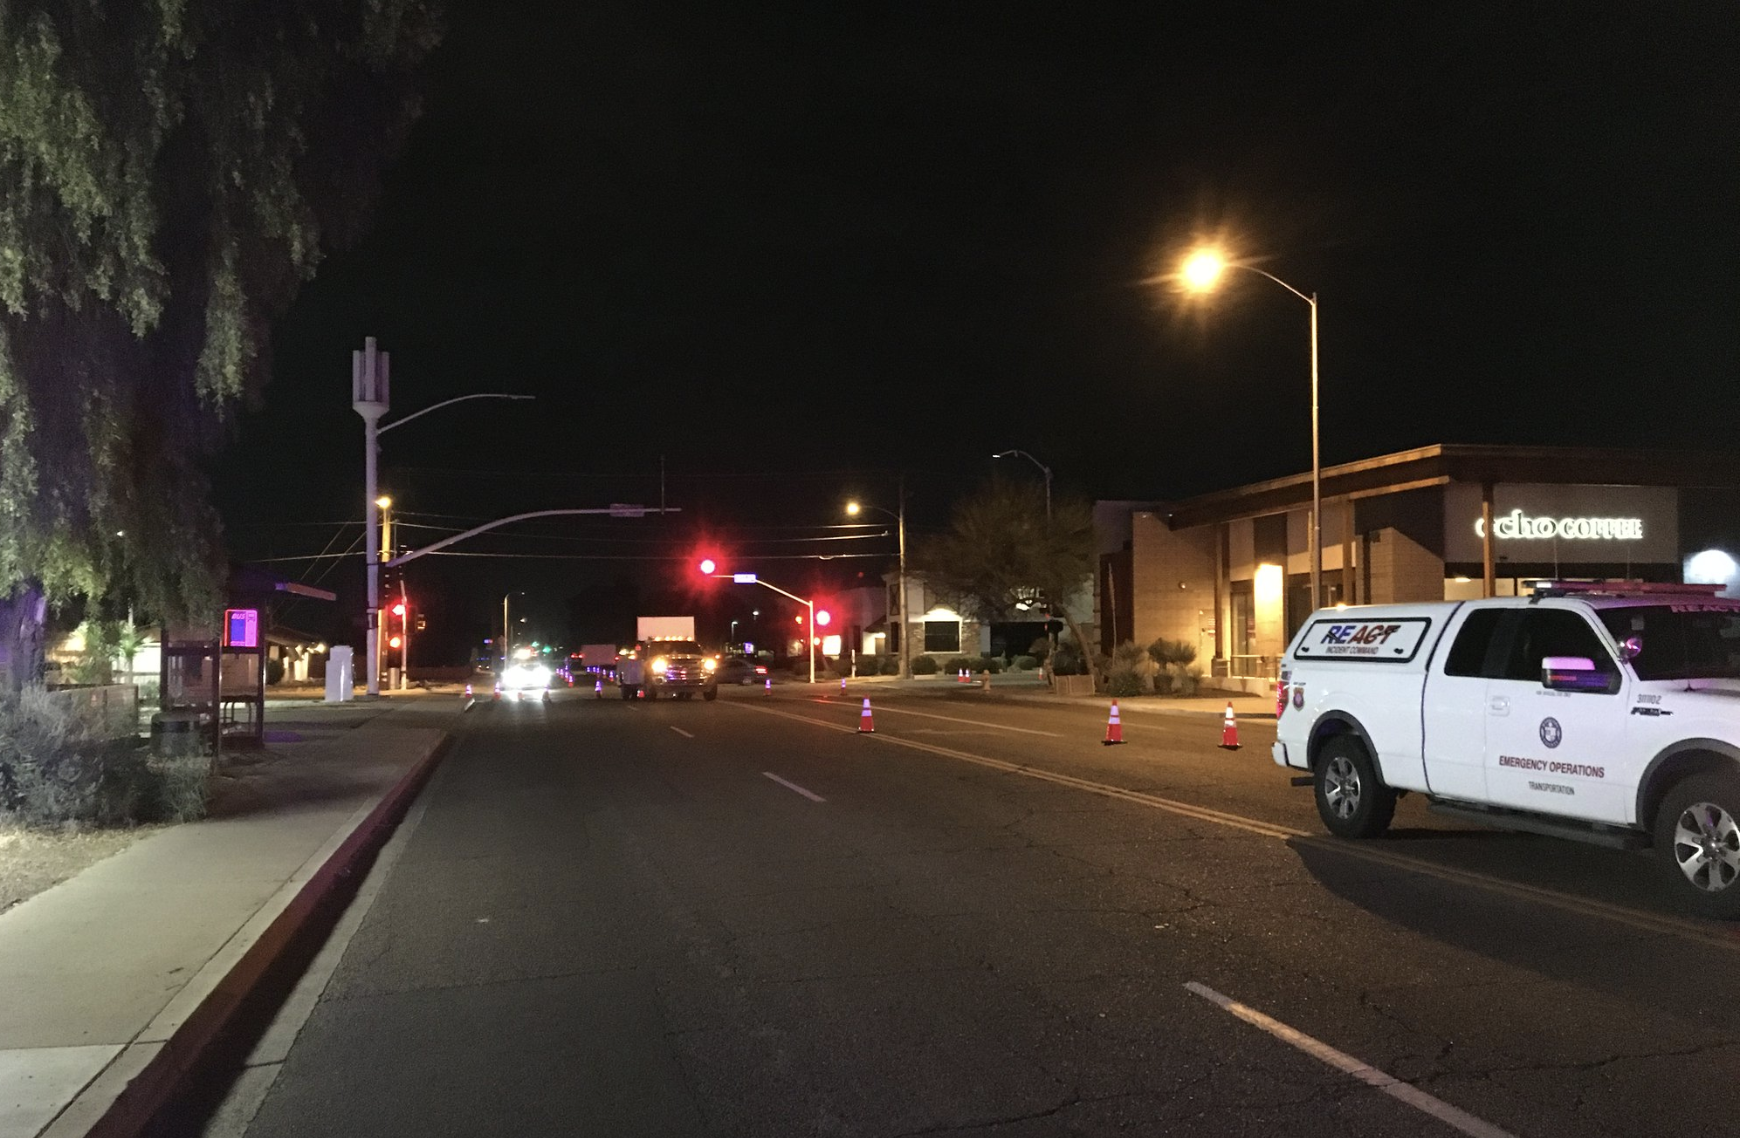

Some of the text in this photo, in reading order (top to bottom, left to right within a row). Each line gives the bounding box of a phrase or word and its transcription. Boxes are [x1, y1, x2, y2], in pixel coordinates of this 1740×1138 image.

[1320, 625, 1401, 645] REACT
[1325, 646, 1379, 654] INCIDENT COMMAND
[1499, 755, 1605, 779] EMERGENCY OPERATIONS
[1528, 781, 1575, 795] TRANSPORTATION
